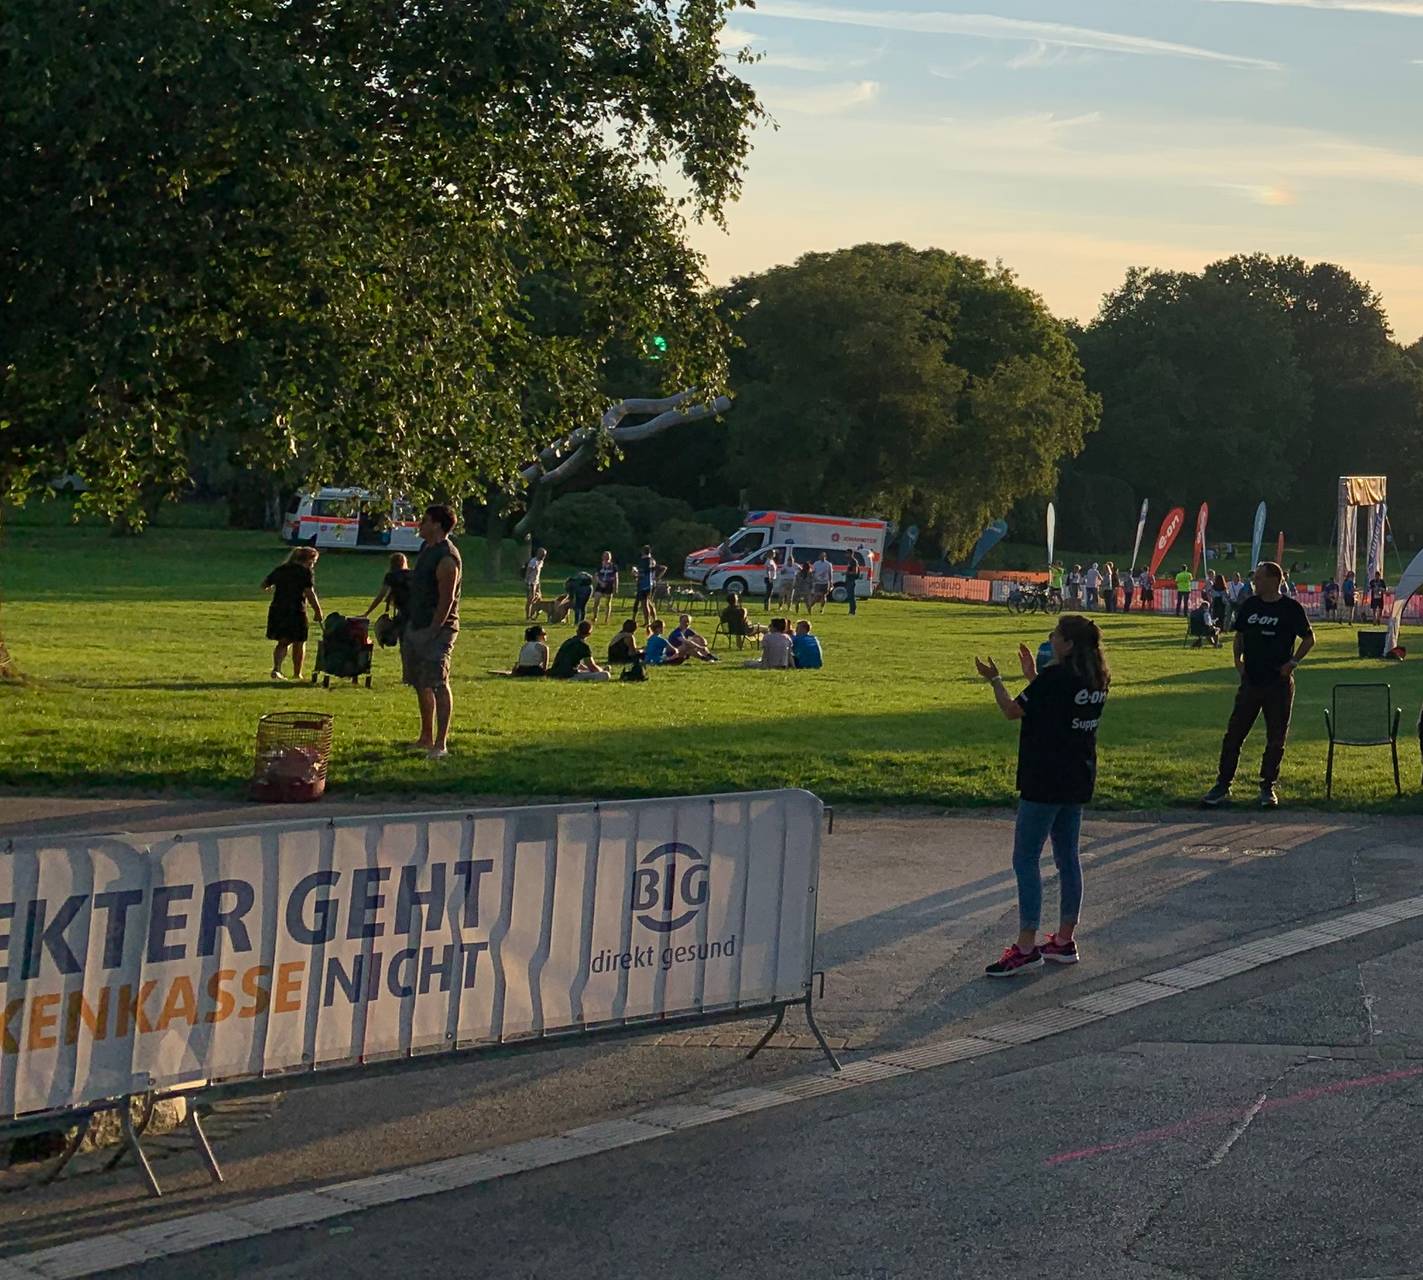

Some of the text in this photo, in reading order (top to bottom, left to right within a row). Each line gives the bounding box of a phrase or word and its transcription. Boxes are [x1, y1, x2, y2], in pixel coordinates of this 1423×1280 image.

[286, 859, 494, 945] GEHT
[631, 863, 709, 911] BIG
[323, 941, 488, 1007] NICHT
[591, 935, 736, 974] direkt gesund
